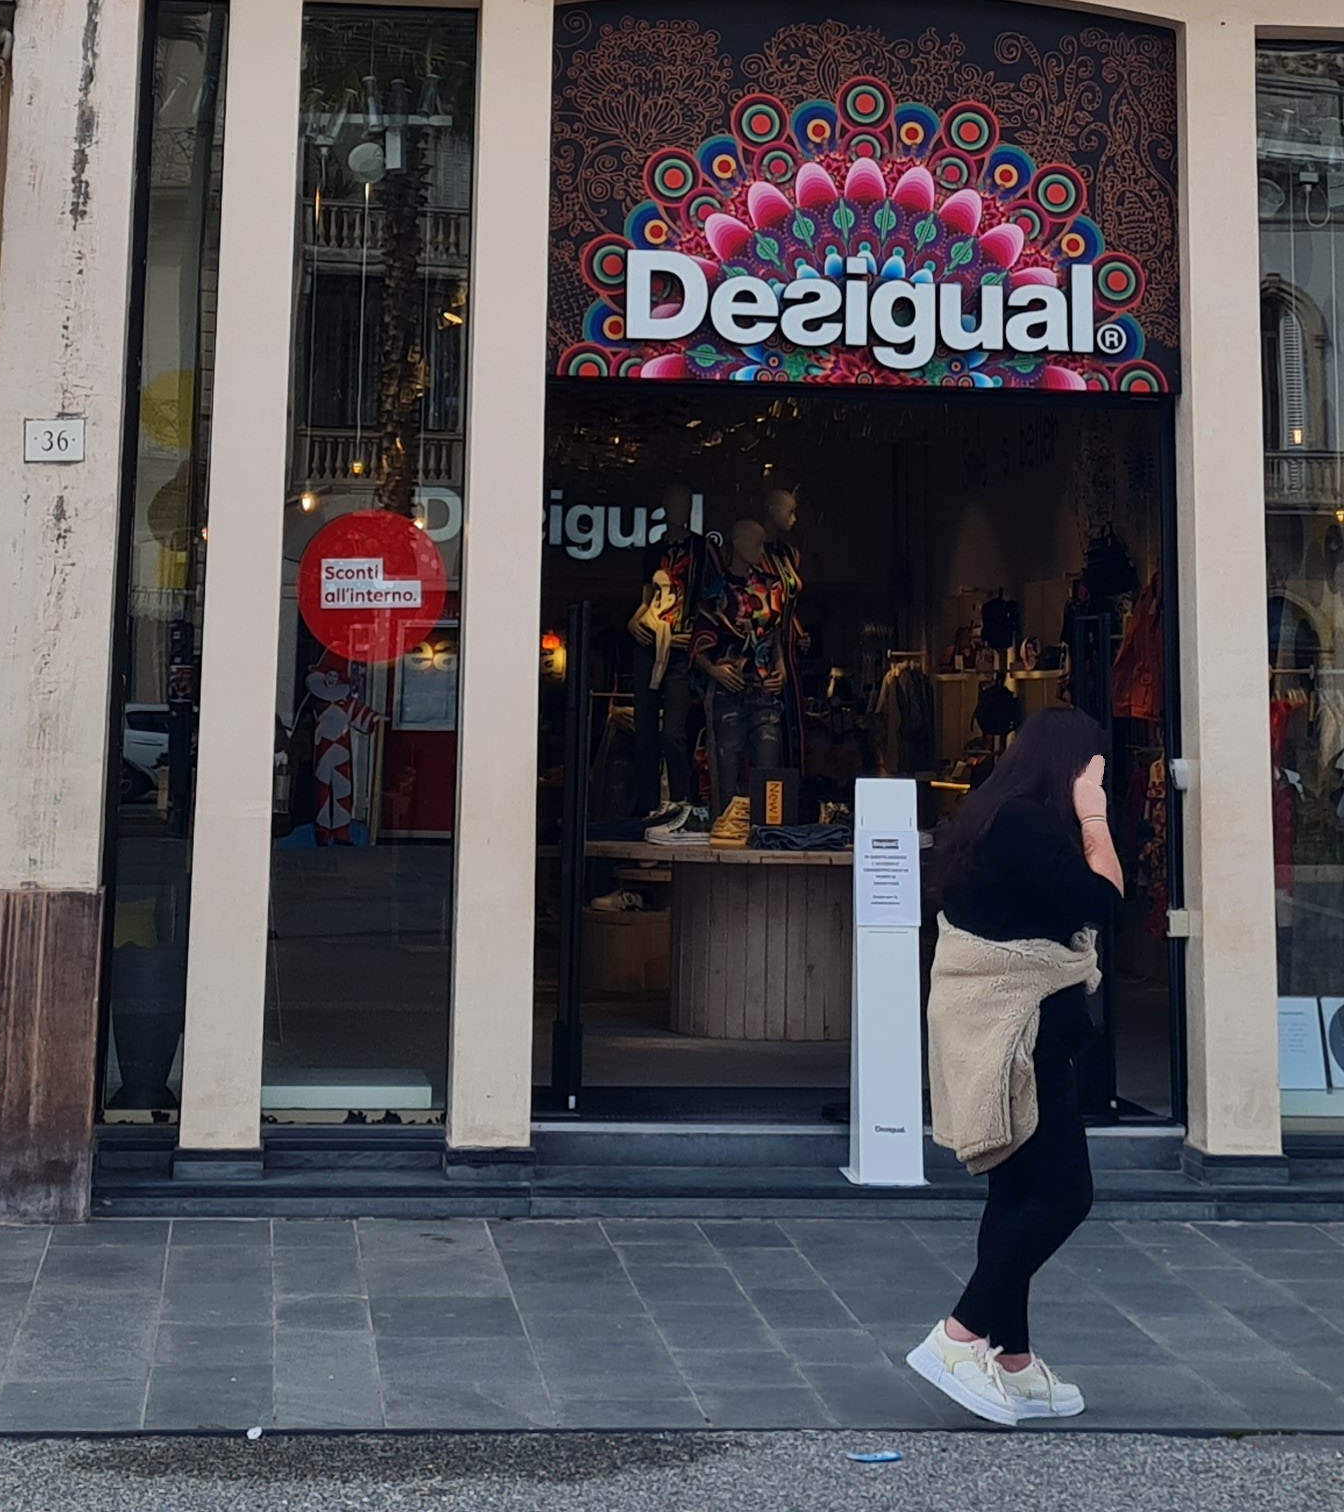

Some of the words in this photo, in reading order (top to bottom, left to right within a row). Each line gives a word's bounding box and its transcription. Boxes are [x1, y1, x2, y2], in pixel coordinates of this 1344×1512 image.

[40, 429, 69, 452] 36
[324, 565, 379, 580] Sconti
[324, 587, 417, 603] all'interno.
